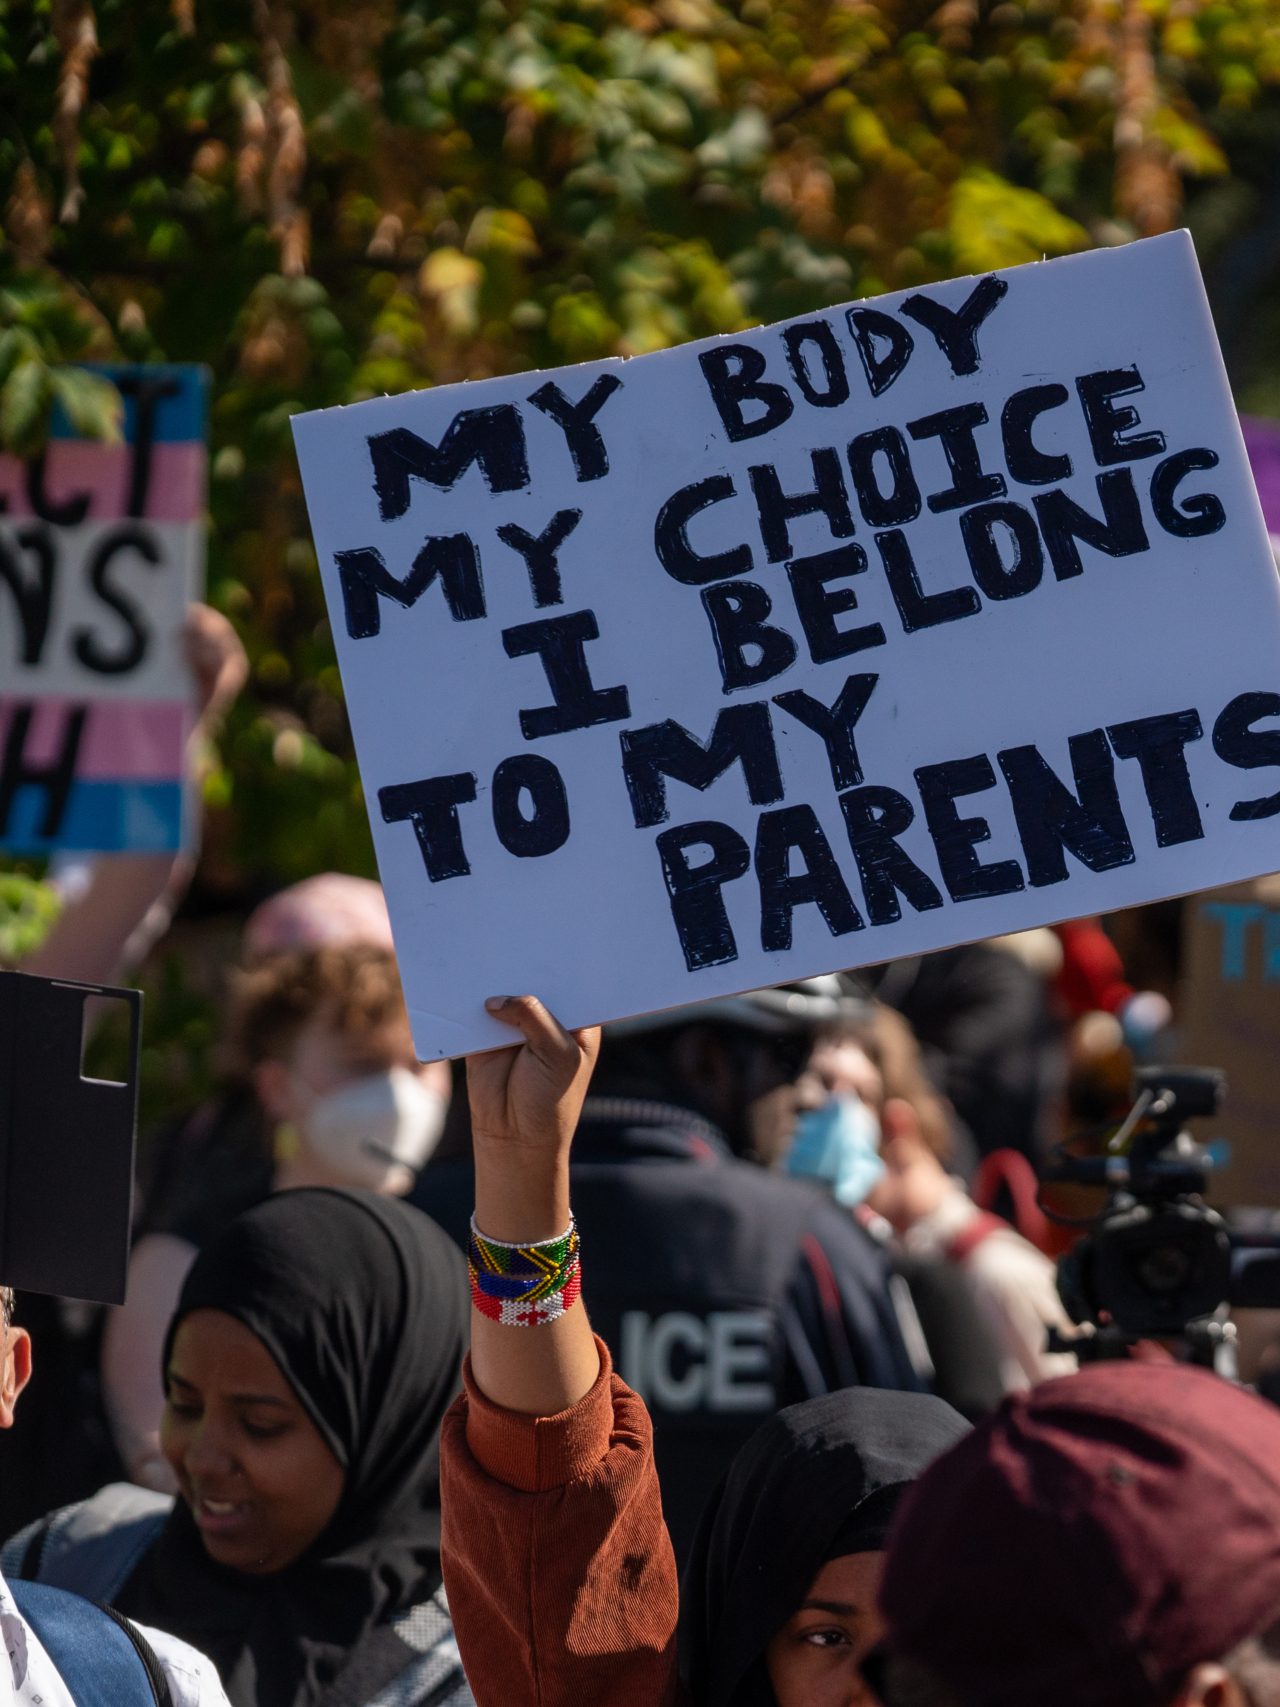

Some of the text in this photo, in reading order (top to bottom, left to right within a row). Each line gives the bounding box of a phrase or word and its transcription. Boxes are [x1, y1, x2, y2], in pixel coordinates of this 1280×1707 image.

[333, 507, 584, 640] MY
[653, 362, 1168, 585] CHOICE
[367, 273, 1008, 522] MY BODY
[501, 609, 630, 740] I
[699, 447, 1227, 694] BELONG
[377, 673, 879, 882] TO MY
